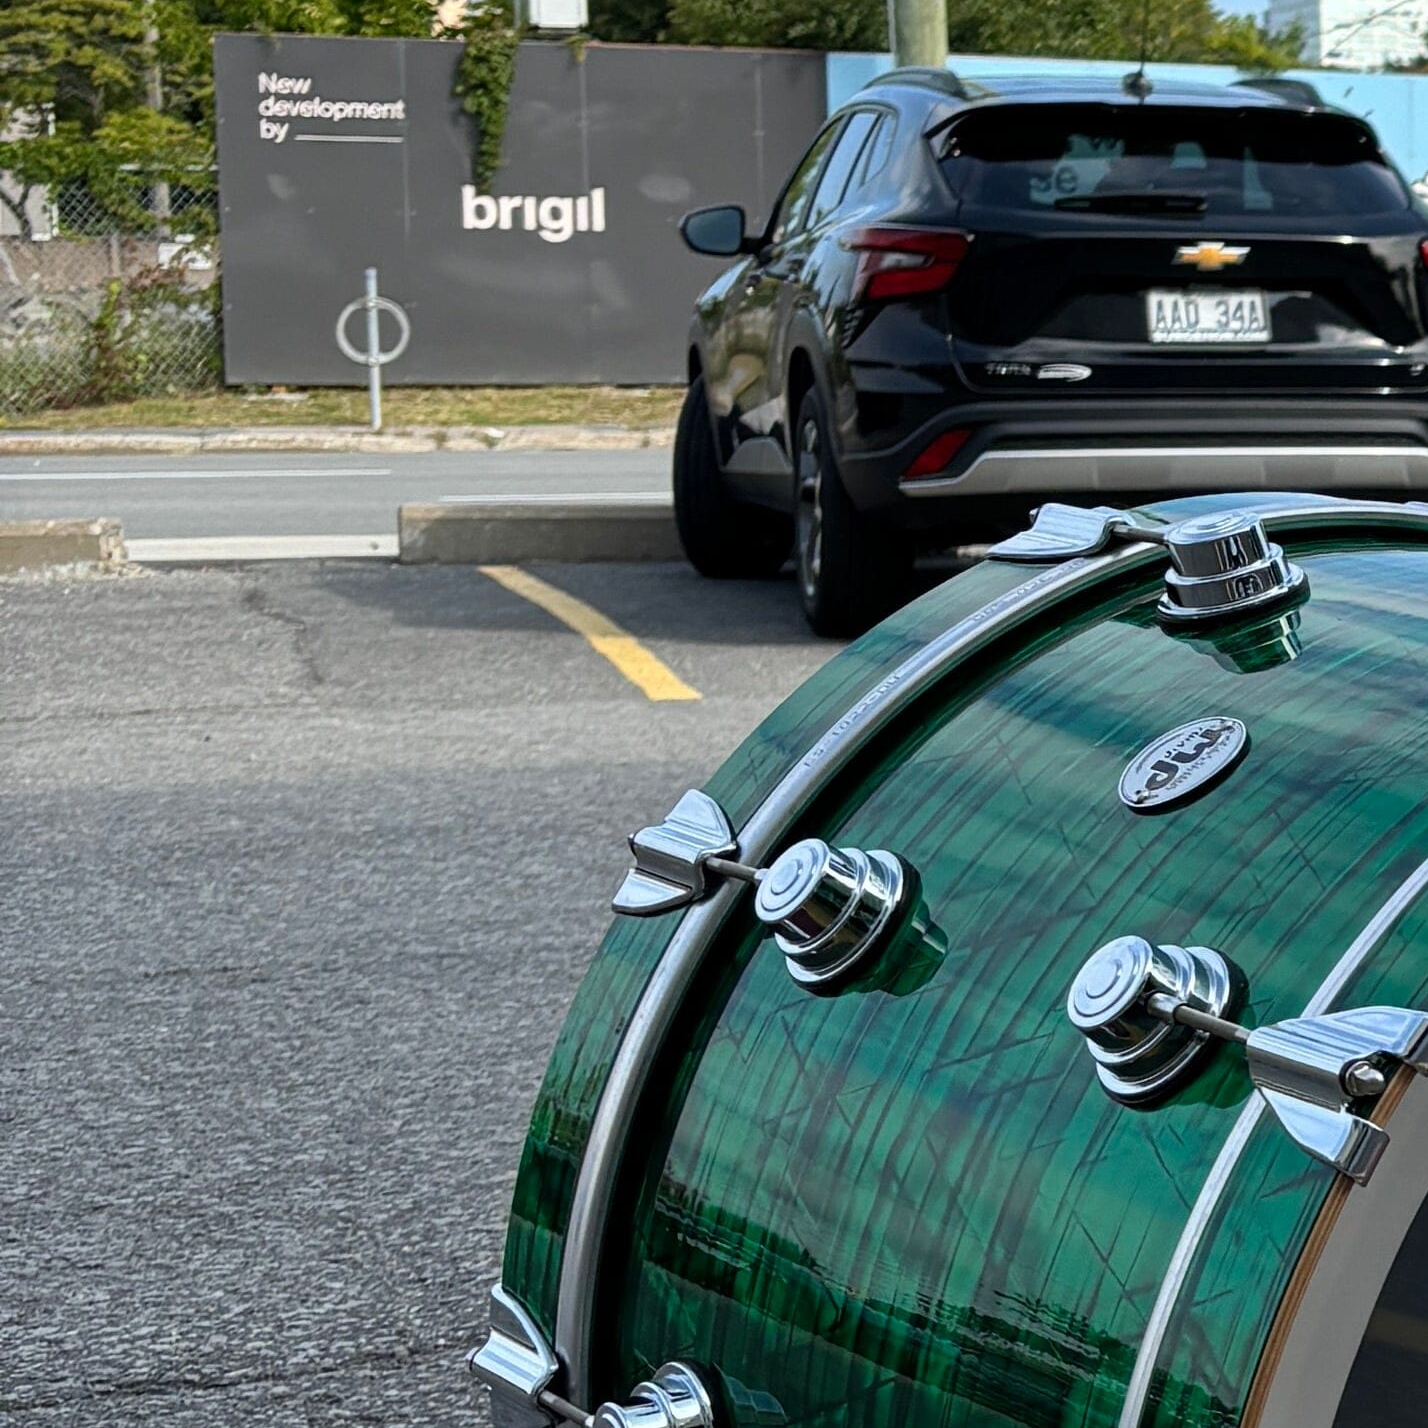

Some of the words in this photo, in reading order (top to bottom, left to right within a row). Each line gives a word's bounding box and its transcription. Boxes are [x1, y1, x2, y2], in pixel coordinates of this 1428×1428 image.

[258, 72, 312, 94] New
[258, 95, 406, 121] development
[260, 118, 289, 143] by
[461, 184, 606, 243] brigil
